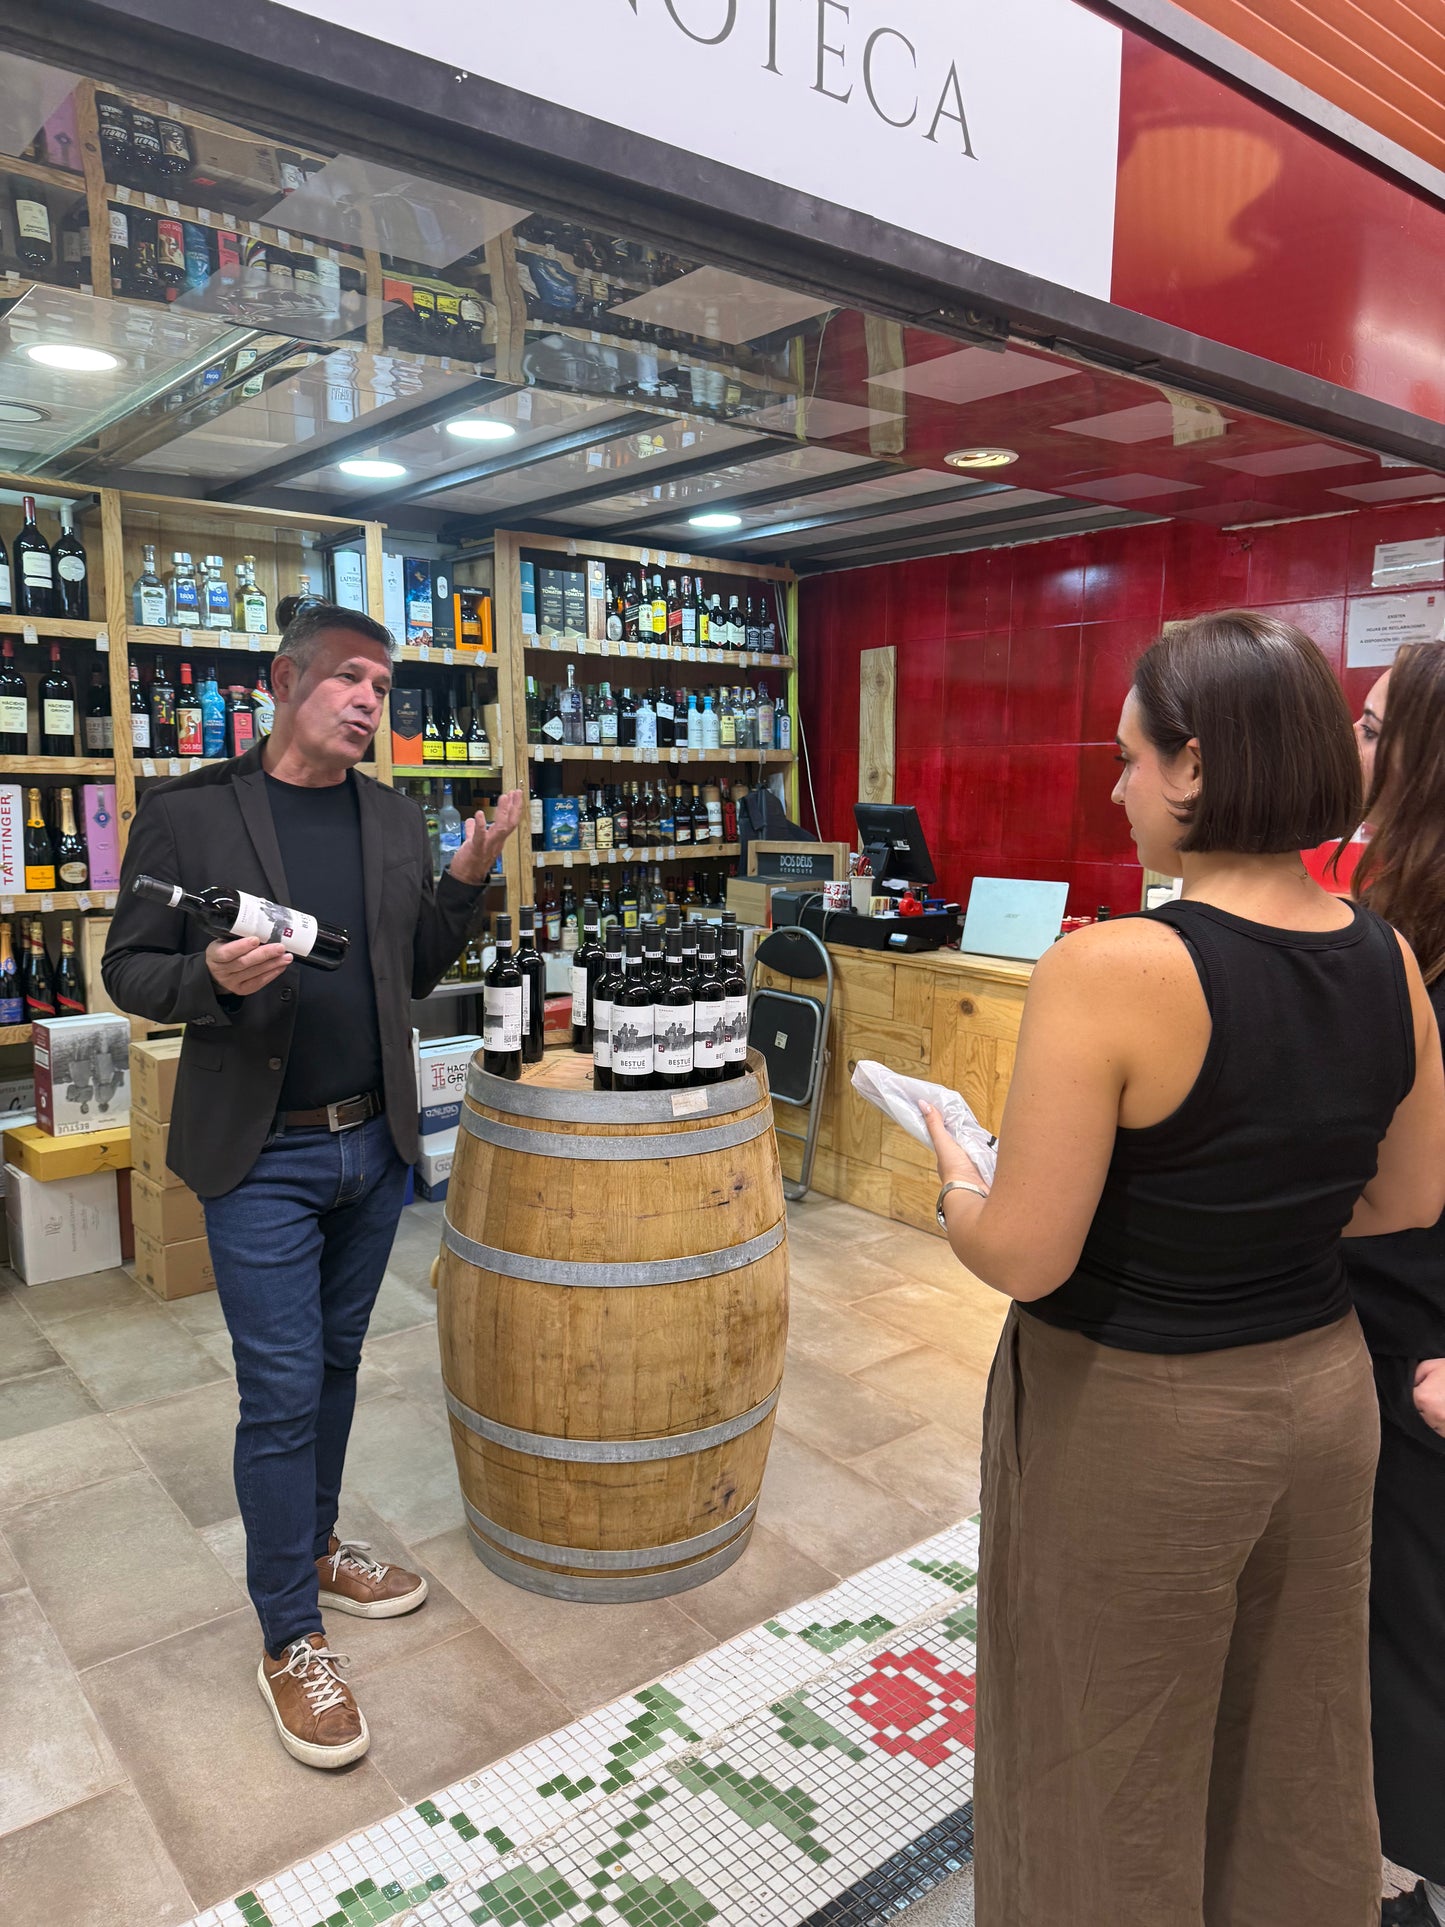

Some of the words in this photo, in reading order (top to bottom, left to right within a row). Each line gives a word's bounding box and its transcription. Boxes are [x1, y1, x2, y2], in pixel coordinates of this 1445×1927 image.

[628, 0, 980, 161] TECA
[0, 794, 14, 886] TAITTINGER
[780, 855, 795, 867] DOS
[447, 1063, 468, 1073] HACI
[620, 1059, 646, 1067] BESTUÉ
[447, 1073, 467, 1084] GRI
